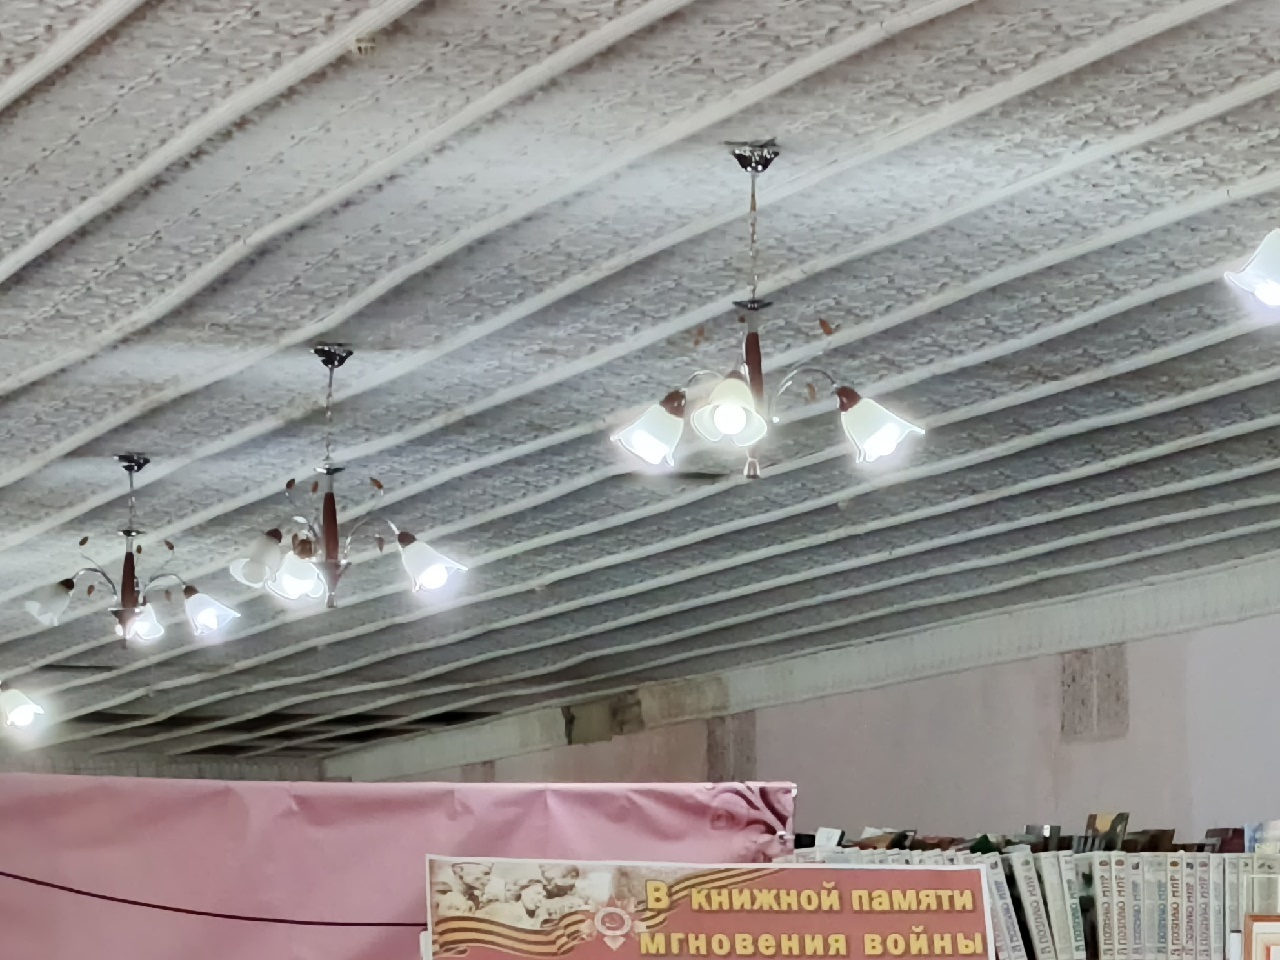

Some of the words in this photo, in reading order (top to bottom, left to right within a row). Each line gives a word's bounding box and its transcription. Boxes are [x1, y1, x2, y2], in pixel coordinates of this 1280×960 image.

[645, 880, 669, 909] В
[691, 881, 841, 911] книжной
[851, 889, 974, 911] памяти
[640, 932, 848, 956] мгновения
[863, 925, 984, 956] войны
